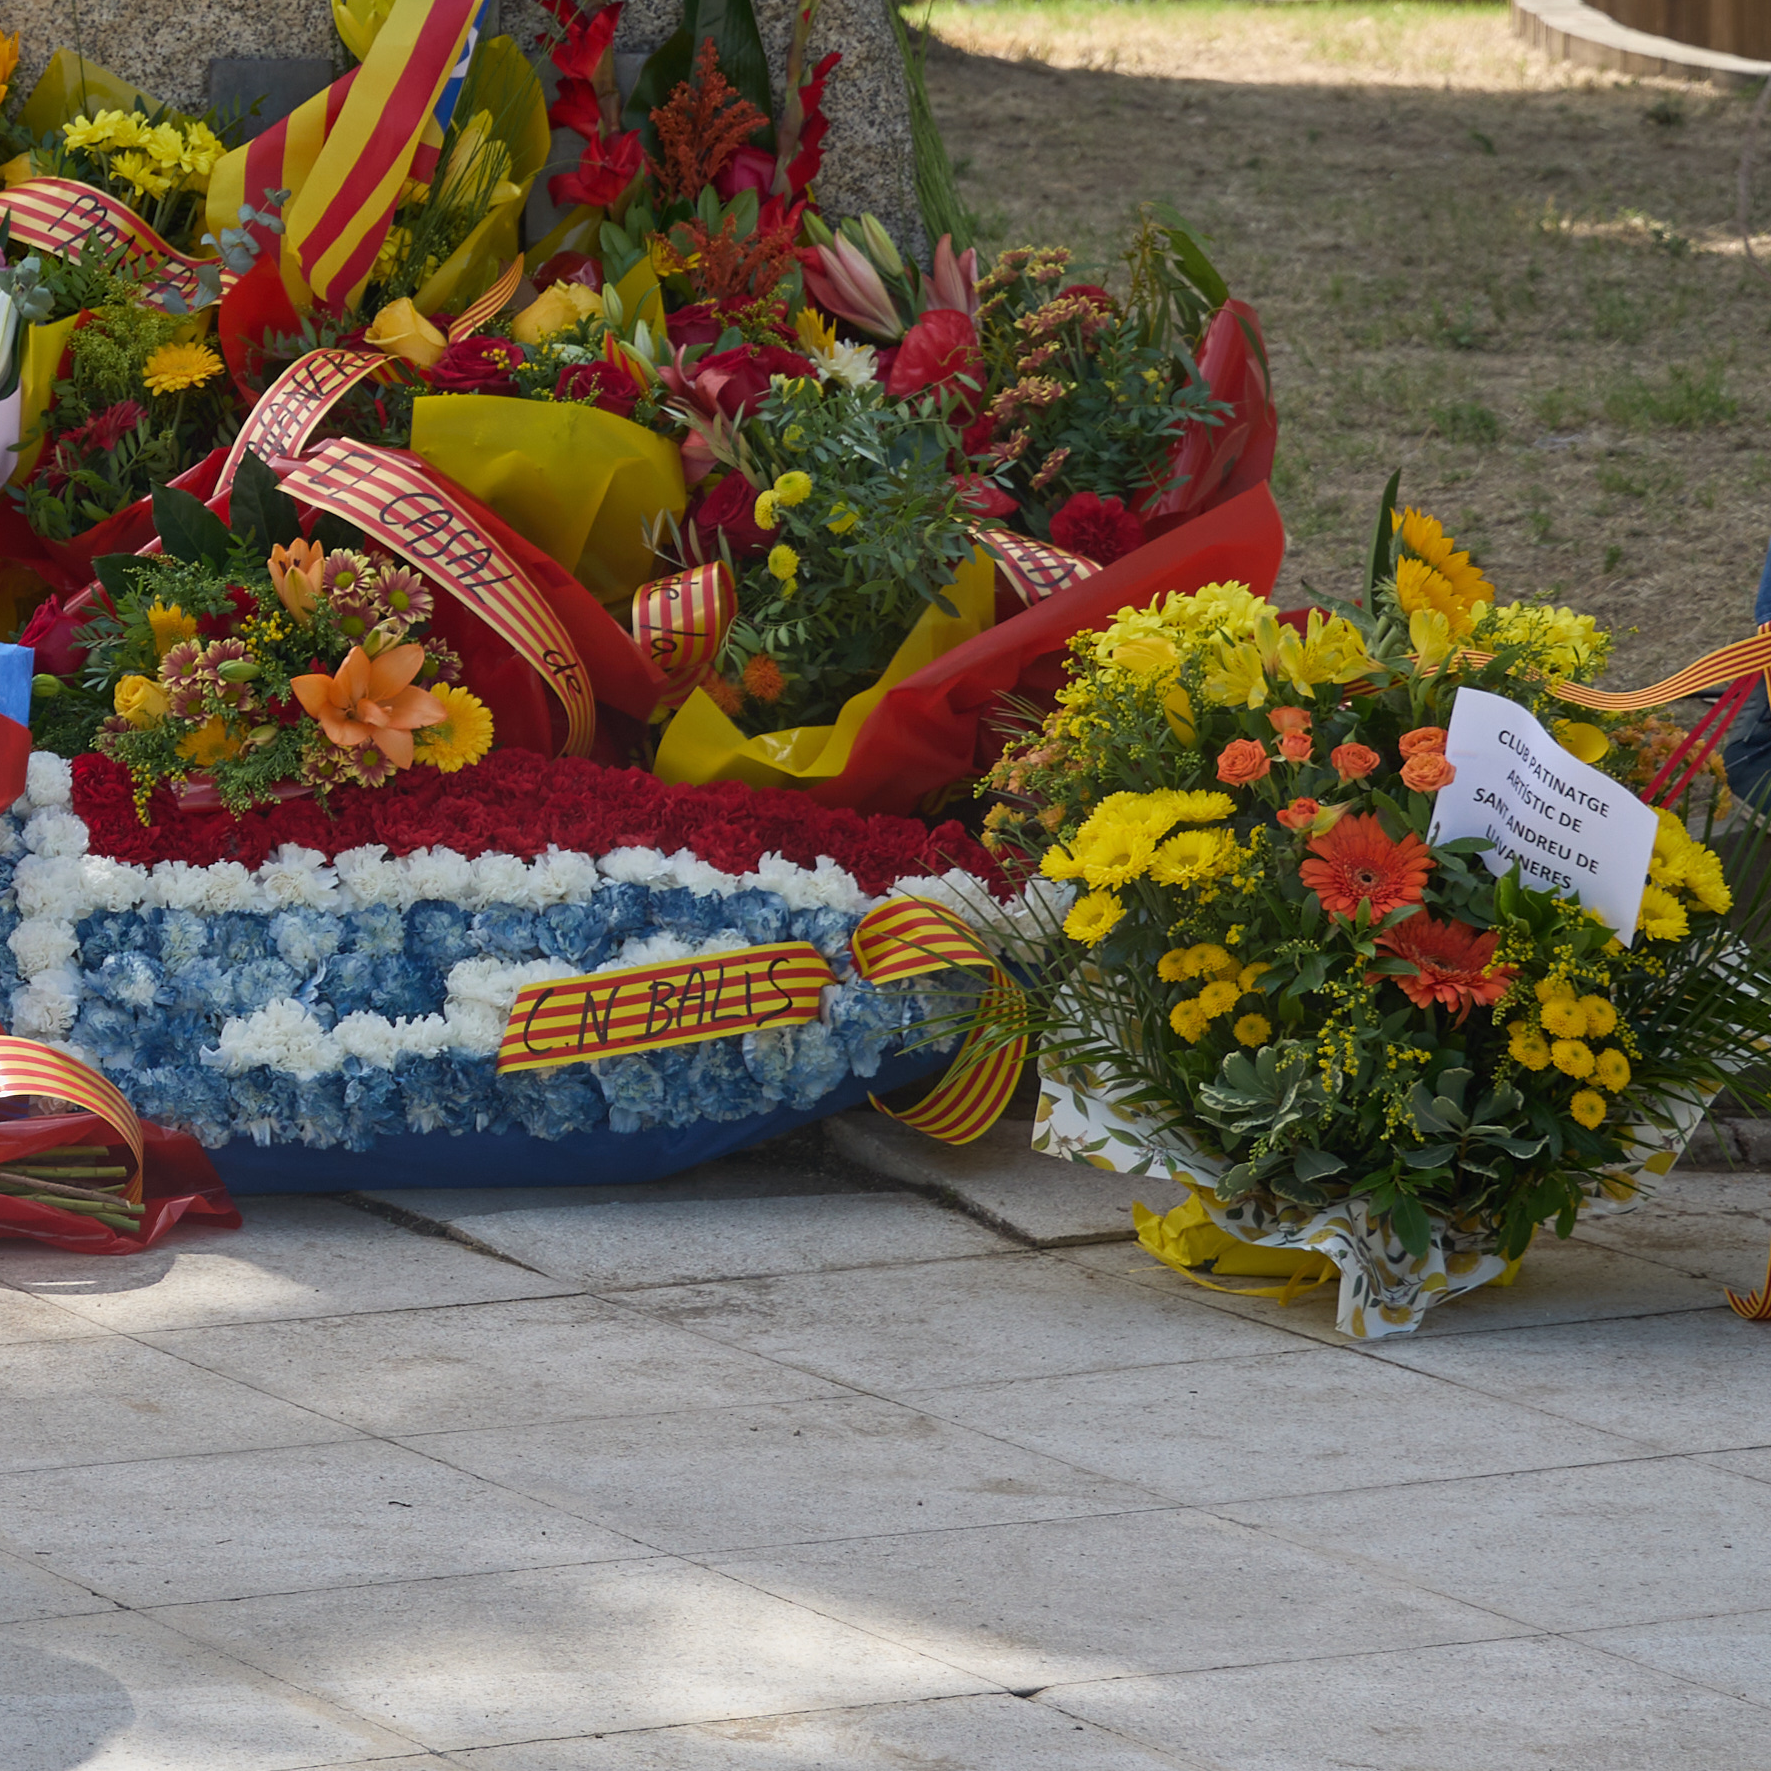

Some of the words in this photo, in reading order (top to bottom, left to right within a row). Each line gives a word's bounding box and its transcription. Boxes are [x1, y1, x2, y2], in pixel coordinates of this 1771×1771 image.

[307, 450, 383, 505] EL
[378, 492, 515, 605] CASAL
[542, 649, 583, 696] de
[639, 624, 711, 660] la
[1497, 729, 1531, 765] CLUB
[1527, 756, 1610, 818] PATINATGE
[1506, 769, 1557, 824] ARTÍSTIC
[1558, 812, 1583, 834] DE
[1472, 787, 1510, 822] SANT
[1505, 814, 1573, 861] ANDREU
[1574, 851, 1600, 876] DE
[1484, 823, 1573, 891] LLAVANERES
